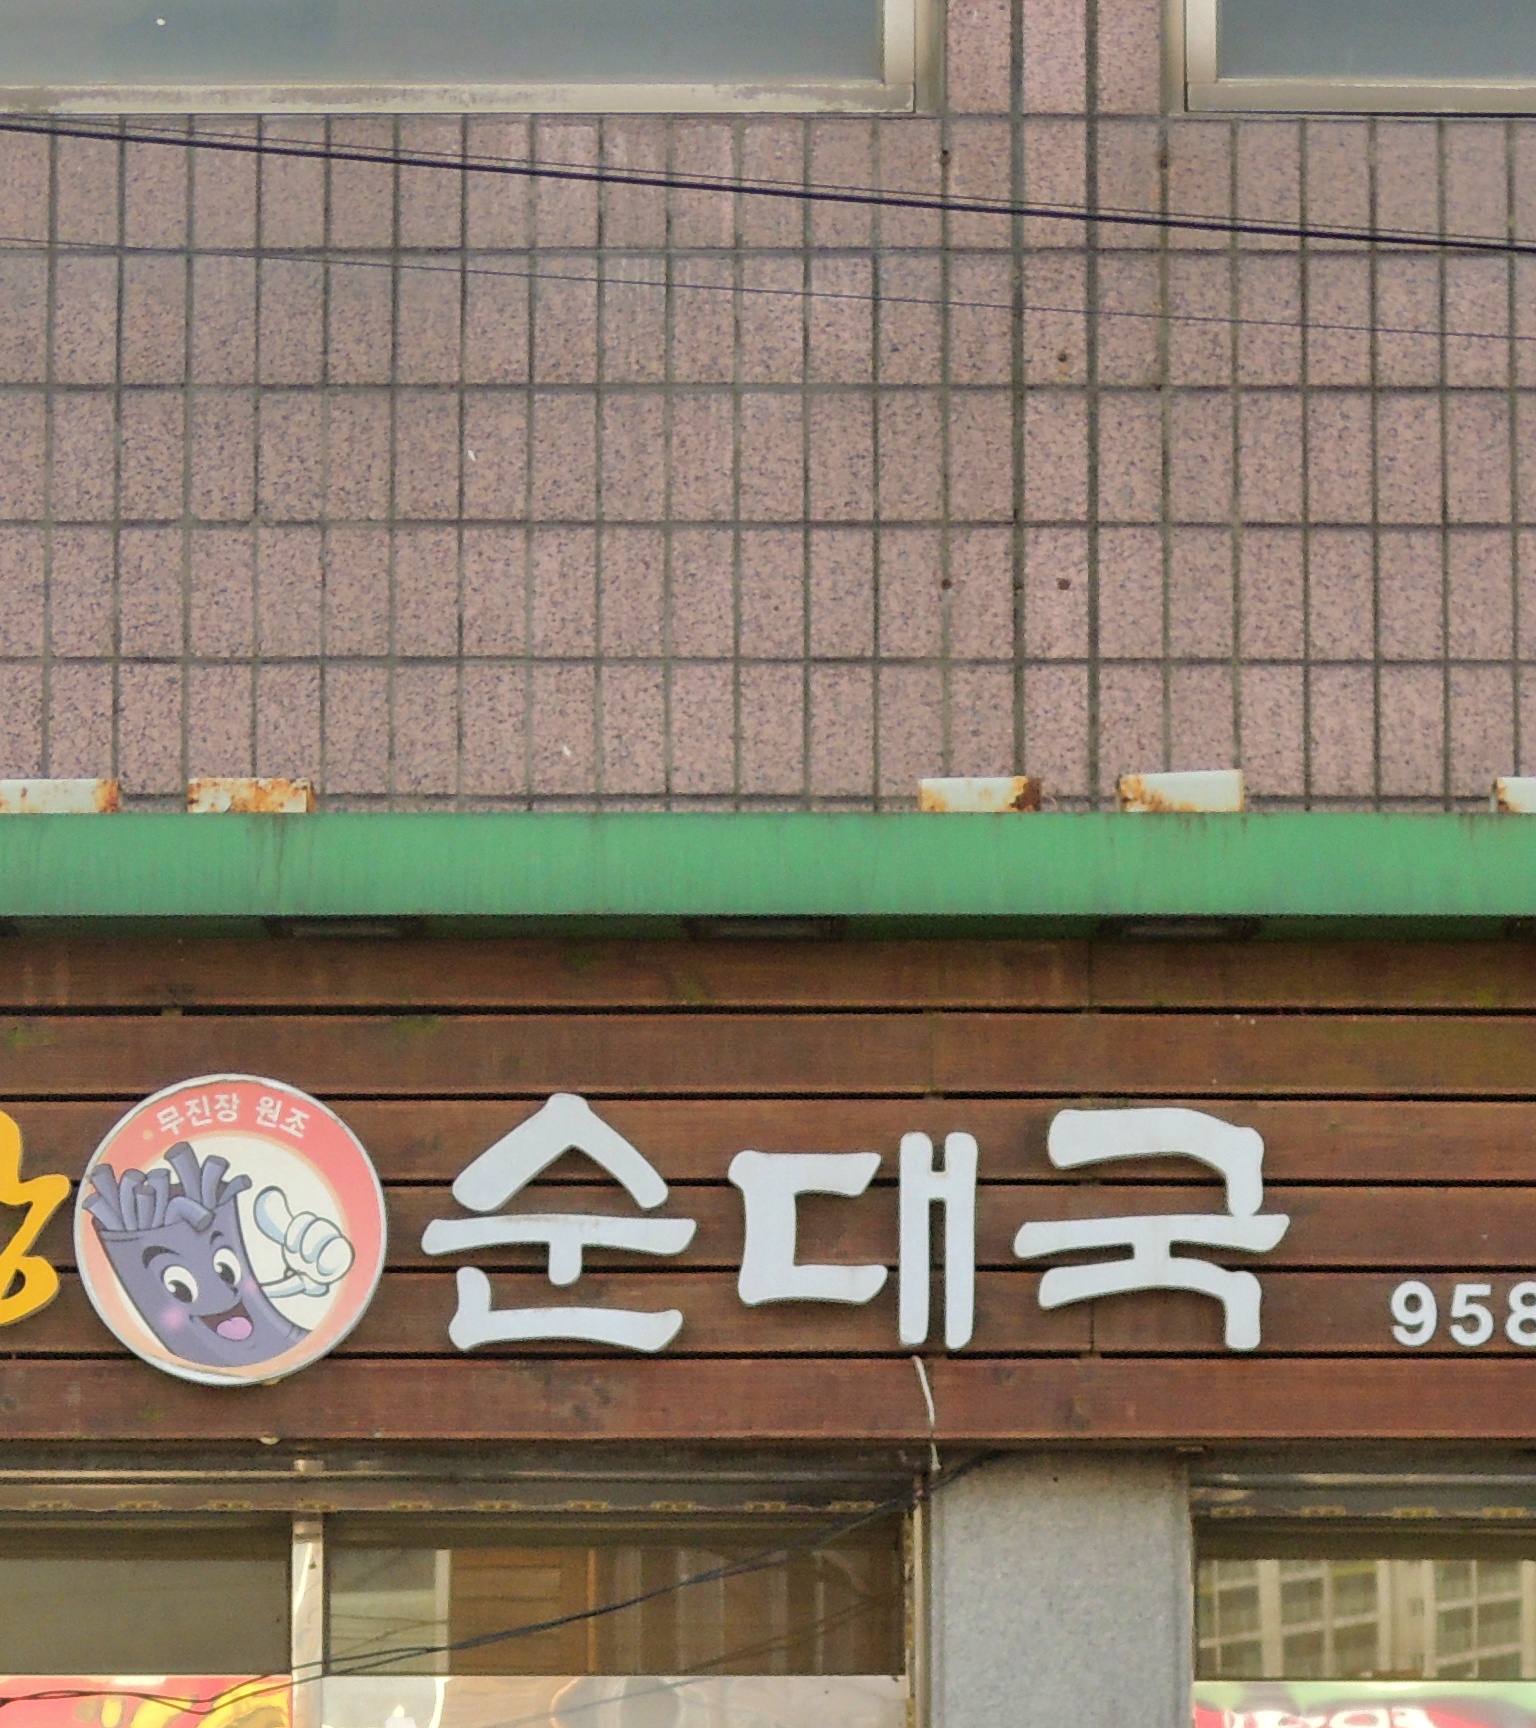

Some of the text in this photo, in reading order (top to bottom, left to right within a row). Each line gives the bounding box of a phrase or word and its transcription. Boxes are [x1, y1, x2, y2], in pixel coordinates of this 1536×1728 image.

[156, 1092, 311, 1138] 무진장 원조
[420, 1092, 1291, 1352] 순대국
